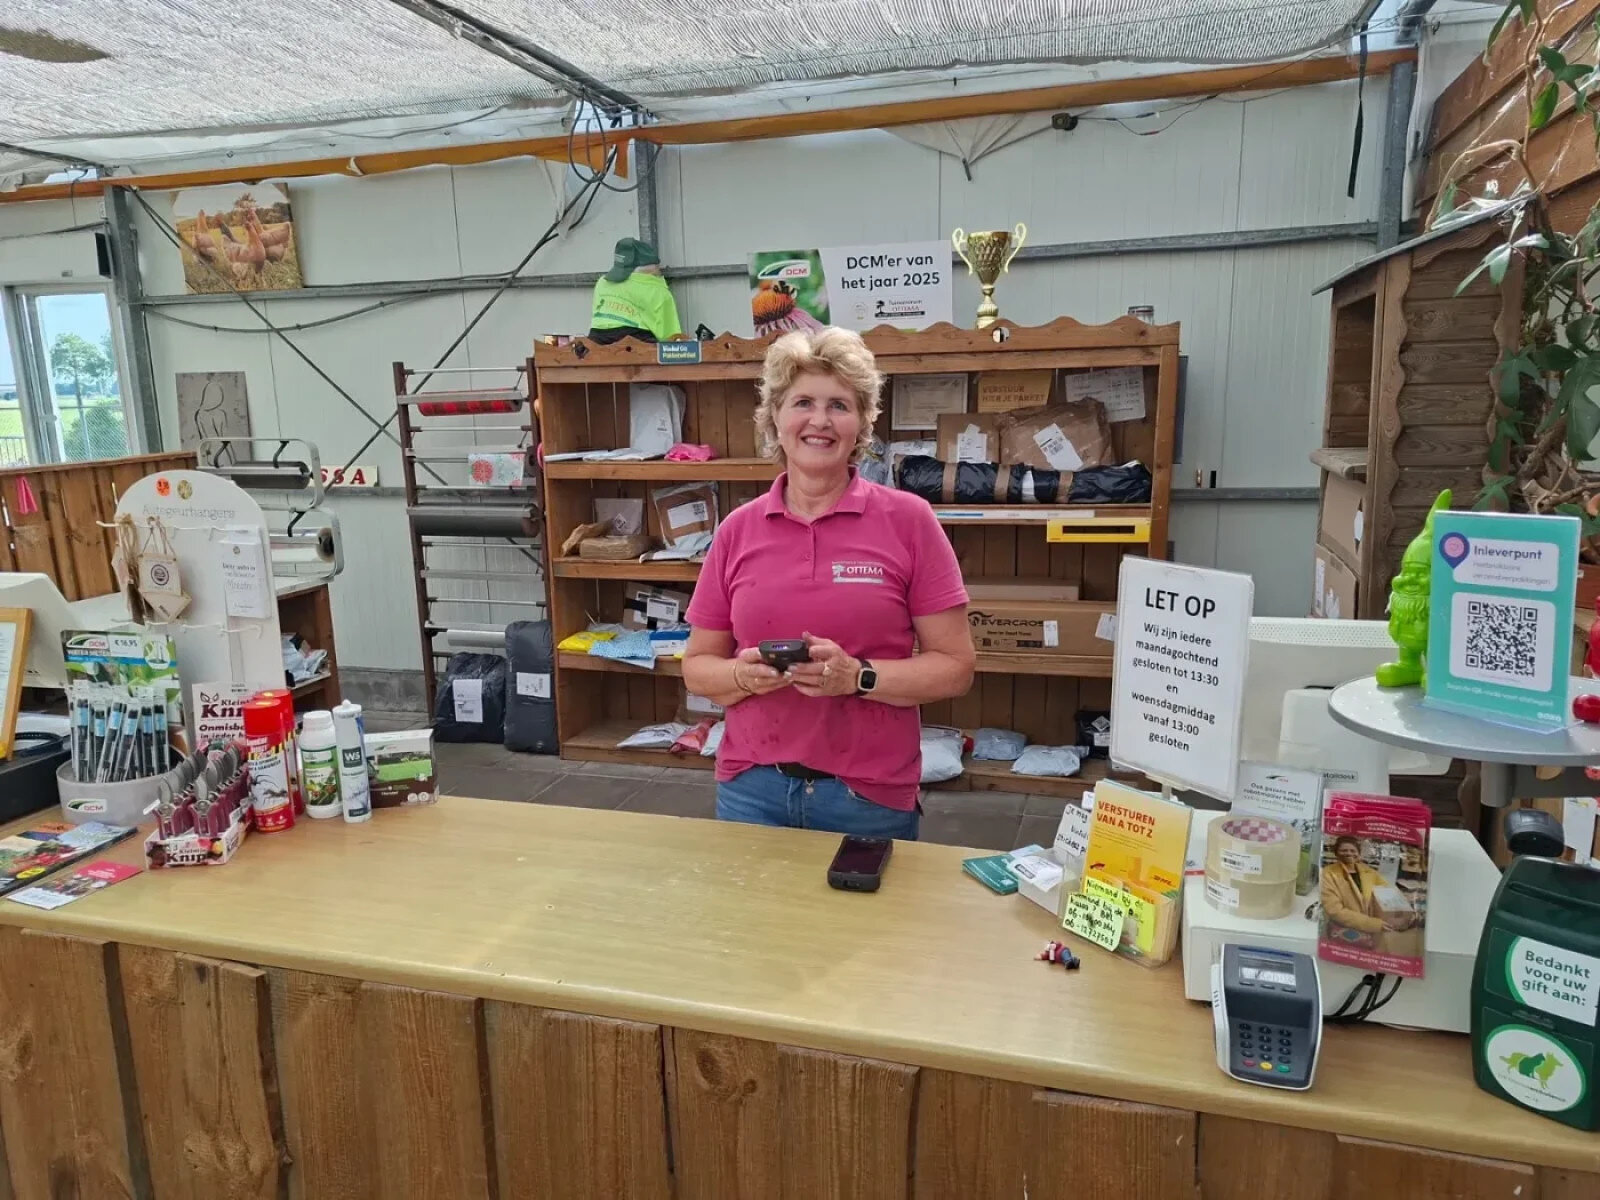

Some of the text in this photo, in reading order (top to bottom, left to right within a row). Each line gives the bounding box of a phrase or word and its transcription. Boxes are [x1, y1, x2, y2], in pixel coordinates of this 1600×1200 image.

[786, 268, 807, 276] DCM
[846, 254, 934, 270] DCM'er van
[842, 272, 940, 291] het jaar 2025
[1474, 545, 1542, 560] Inleverpunt
[846, 566, 883, 576] OTTEMA
[1145, 587, 1216, 619] LET OP
[1143, 622, 1212, 648] Wij zijn iedere
[1136, 640, 1218, 668] maandagochtend
[1132, 657, 1219, 687] gesloten tot 13:30
[1166, 684, 1178, 694] en
[200, 704, 243, 718] Kni
[1131, 691, 1216, 725] woensdagmiddag
[1142, 712, 1200, 736] vanaf 13:00
[1148, 731, 1190, 752] gesloten
[1250, 782, 1264, 790] Ook
[1283, 794, 1306, 805] hebben
[1098, 800, 1156, 826] VERSTUREN
[1096, 812, 1153, 838] VAN A TOT Z
[166, 853, 208, 863] Knip
[1525, 950, 1591, 978] Bedankt
[1525, 966, 1587, 992] voor uw
[1522, 980, 1586, 1006] gift aan:
